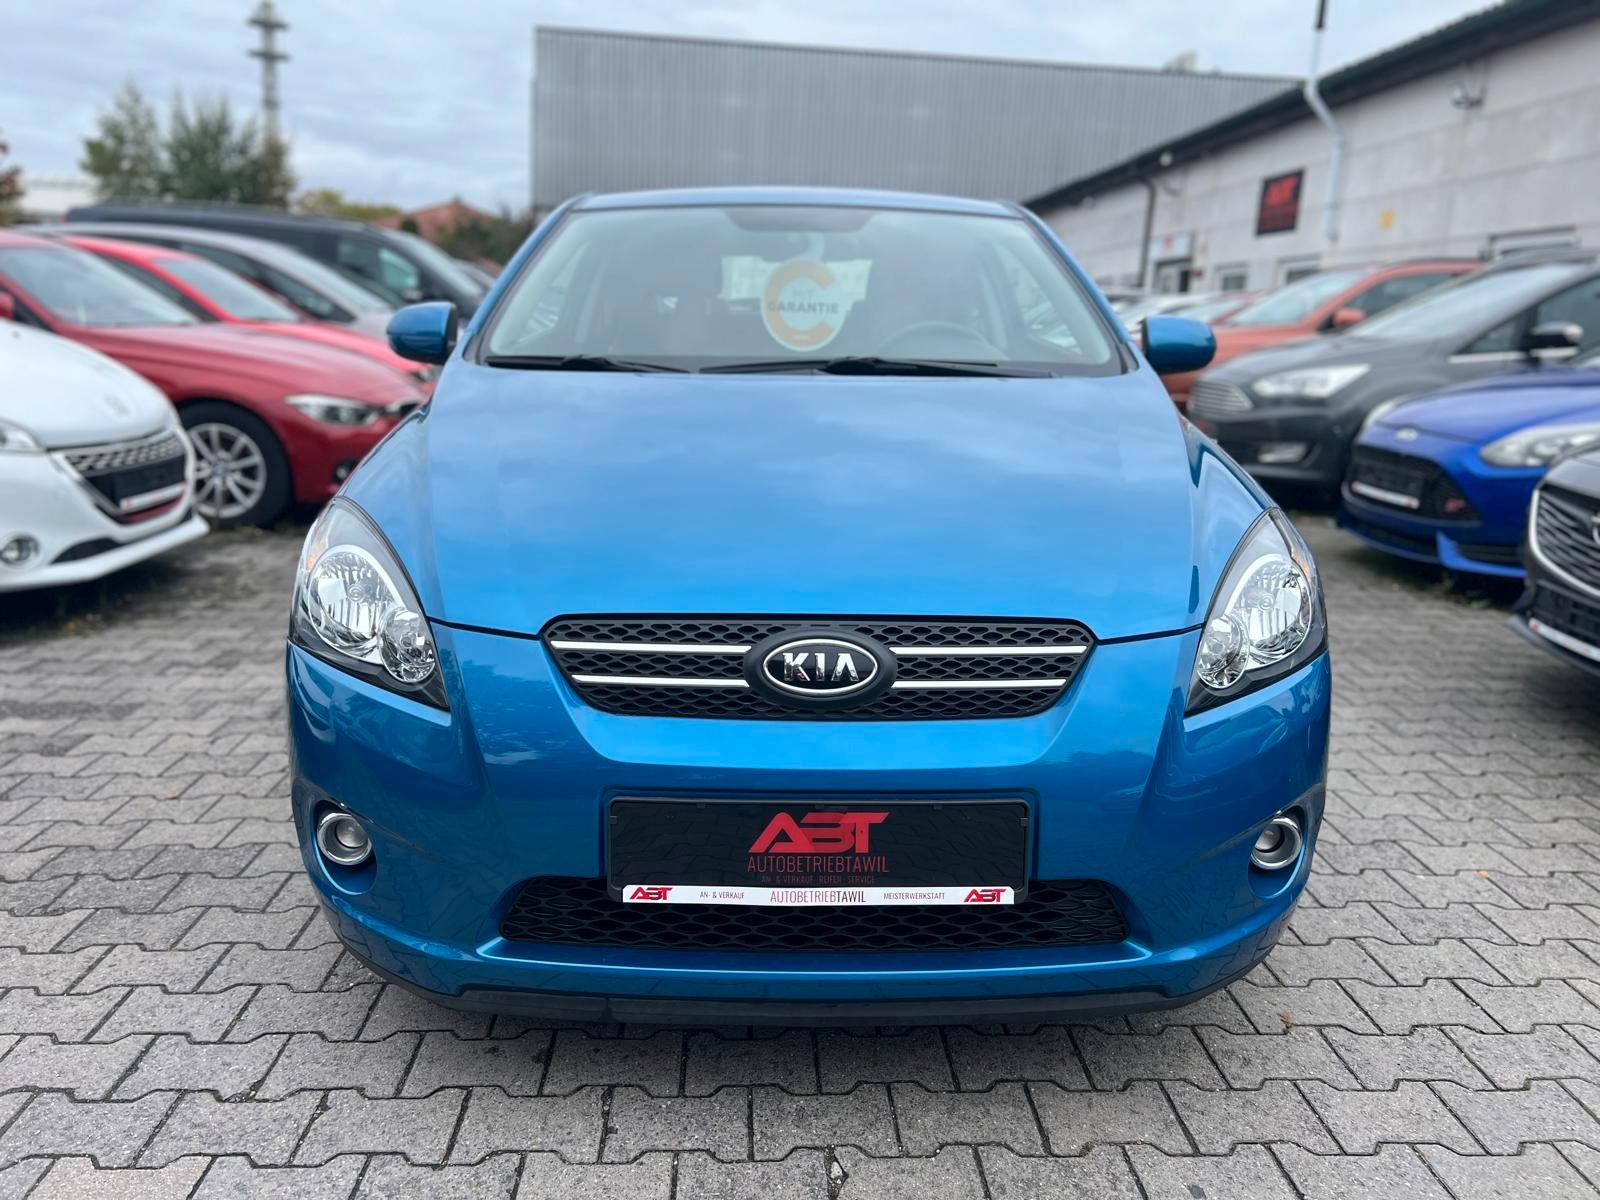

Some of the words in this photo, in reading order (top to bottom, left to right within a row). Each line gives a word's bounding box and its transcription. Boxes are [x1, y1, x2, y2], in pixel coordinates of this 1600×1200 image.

[767, 300, 840, 316] GARANTIE
[782, 652, 860, 682] KIA
[748, 811, 890, 854] ABT
[747, 855, 890, 873] AUTOBETRIEBTAWIL
[629, 886, 673, 901] ABT
[718, 891, 745, 900] VERKAUF
[770, 890, 867, 904] AUTOBETRIEBTAWIL
[883, 892, 945, 901] MEISTERWERKSTATT
[963, 888, 1007, 903] ABT
